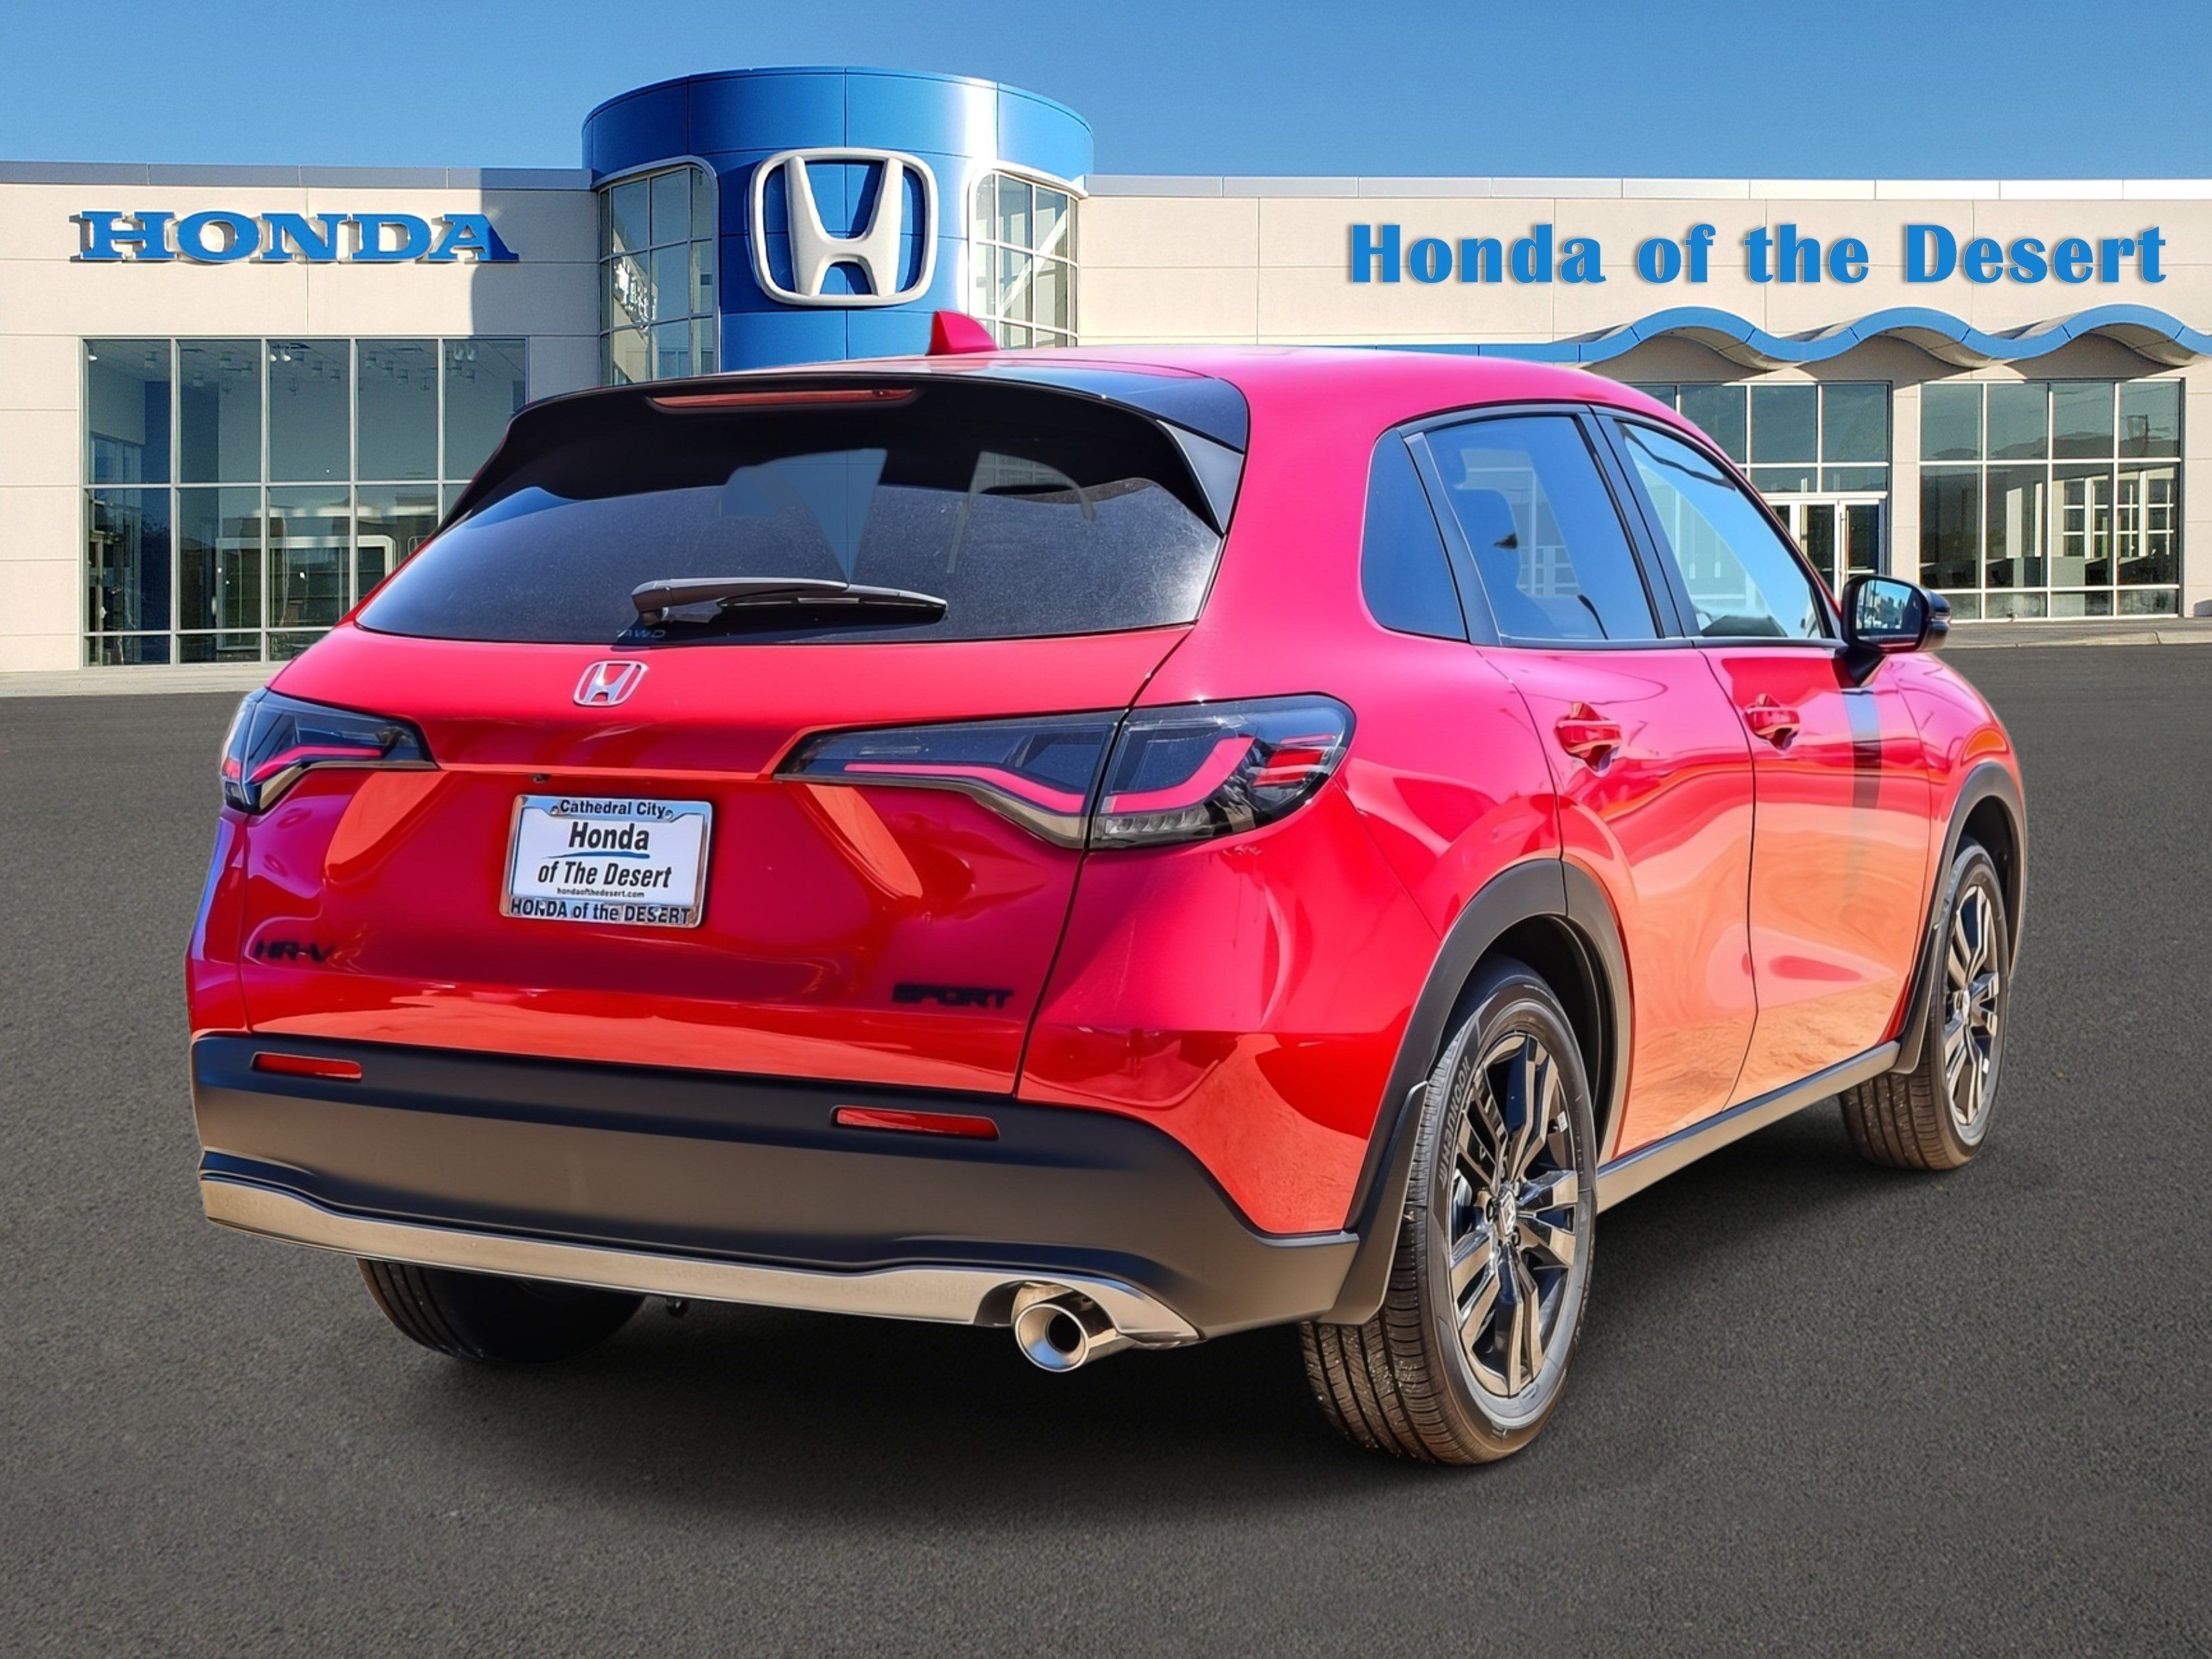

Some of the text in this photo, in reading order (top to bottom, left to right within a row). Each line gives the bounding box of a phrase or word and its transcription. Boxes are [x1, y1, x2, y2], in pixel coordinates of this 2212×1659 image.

[79, 210, 519, 263] HONDA
[1352, 223, 2167, 284] Honda of the Desert
[560, 799, 666, 819] Cathedral City
[568, 821, 650, 851] Honda
[538, 861, 672, 888] of The Desert
[557, 887, 645, 898] hondaofthedesert.com
[511, 898, 690, 924] HONDA of the DESERT
[254, 940, 336, 963] HR-V
[892, 983, 1015, 1010] SPORT
